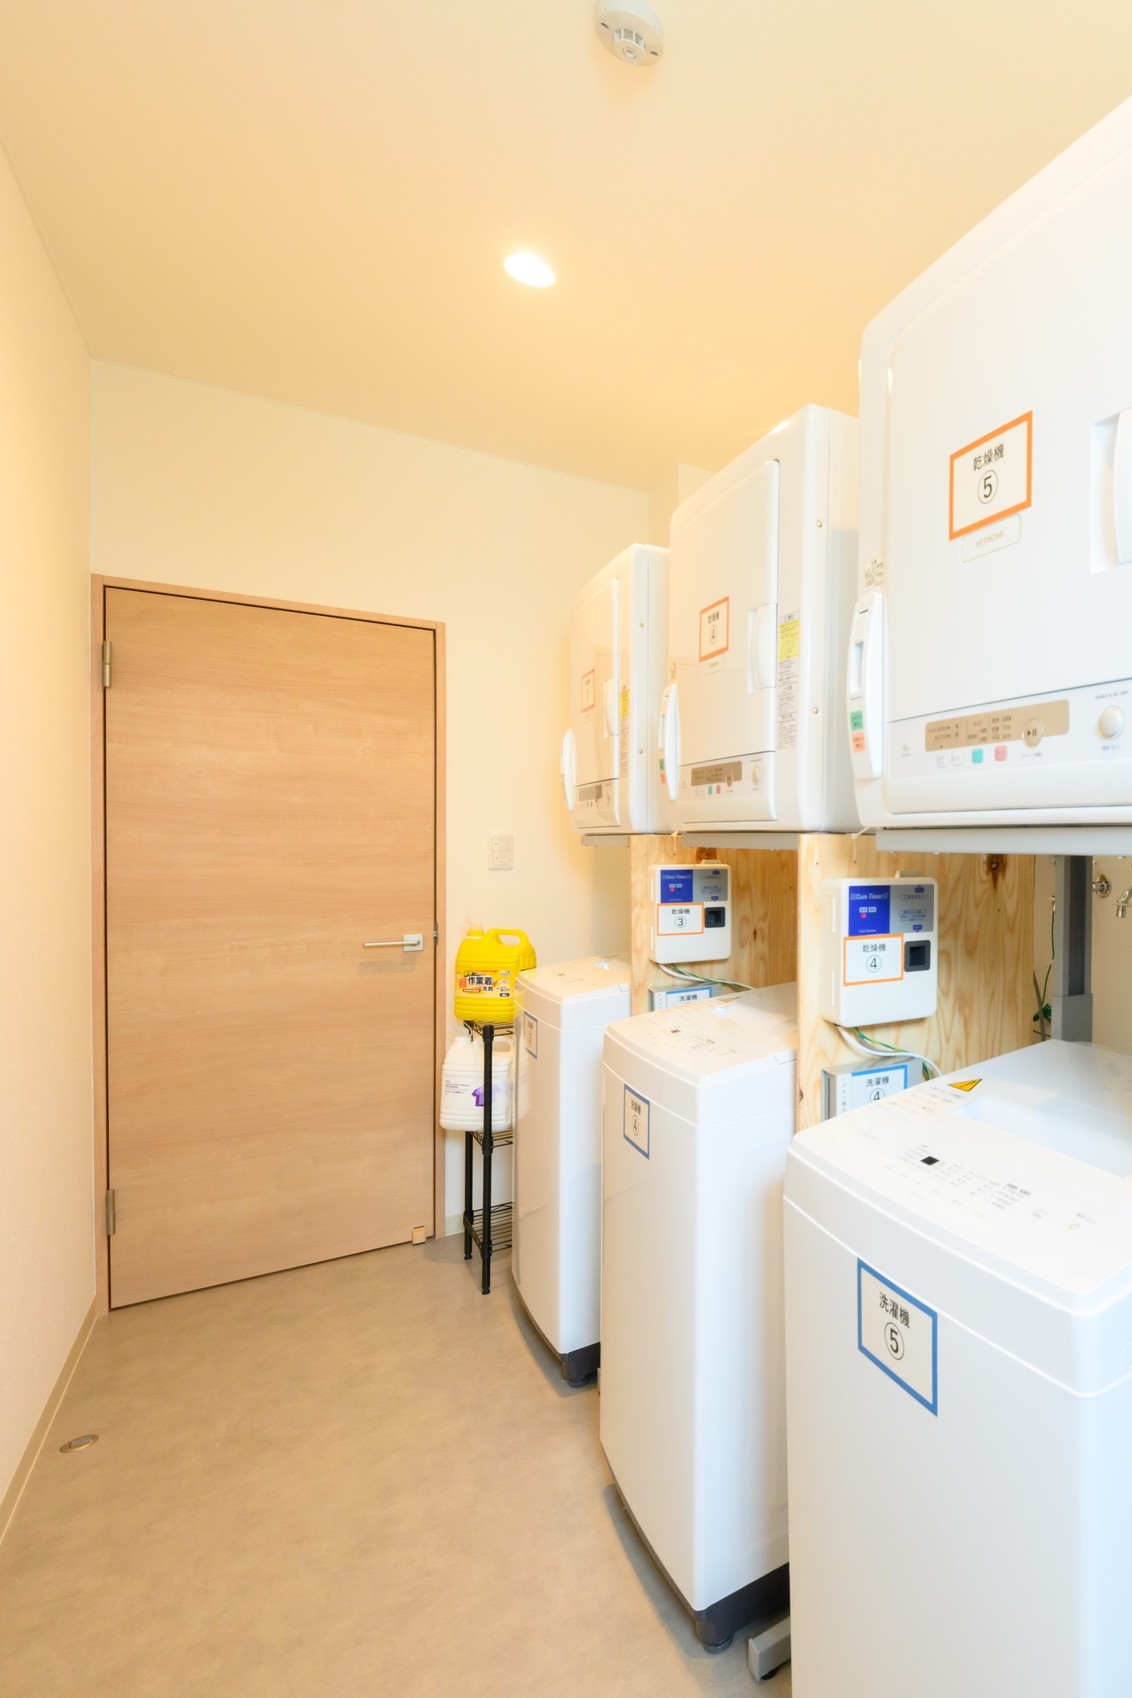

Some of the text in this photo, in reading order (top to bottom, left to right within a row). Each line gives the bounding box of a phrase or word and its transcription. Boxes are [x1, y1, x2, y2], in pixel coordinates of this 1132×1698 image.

[973, 443, 1005, 472] 乾燥機
[976, 530, 1004, 548] HITACHI
[862, 943, 886, 953] 乾燥機
[866, 1076, 889, 1088] 洗濯機
[879, 1291, 911, 1329] 洗濯機
